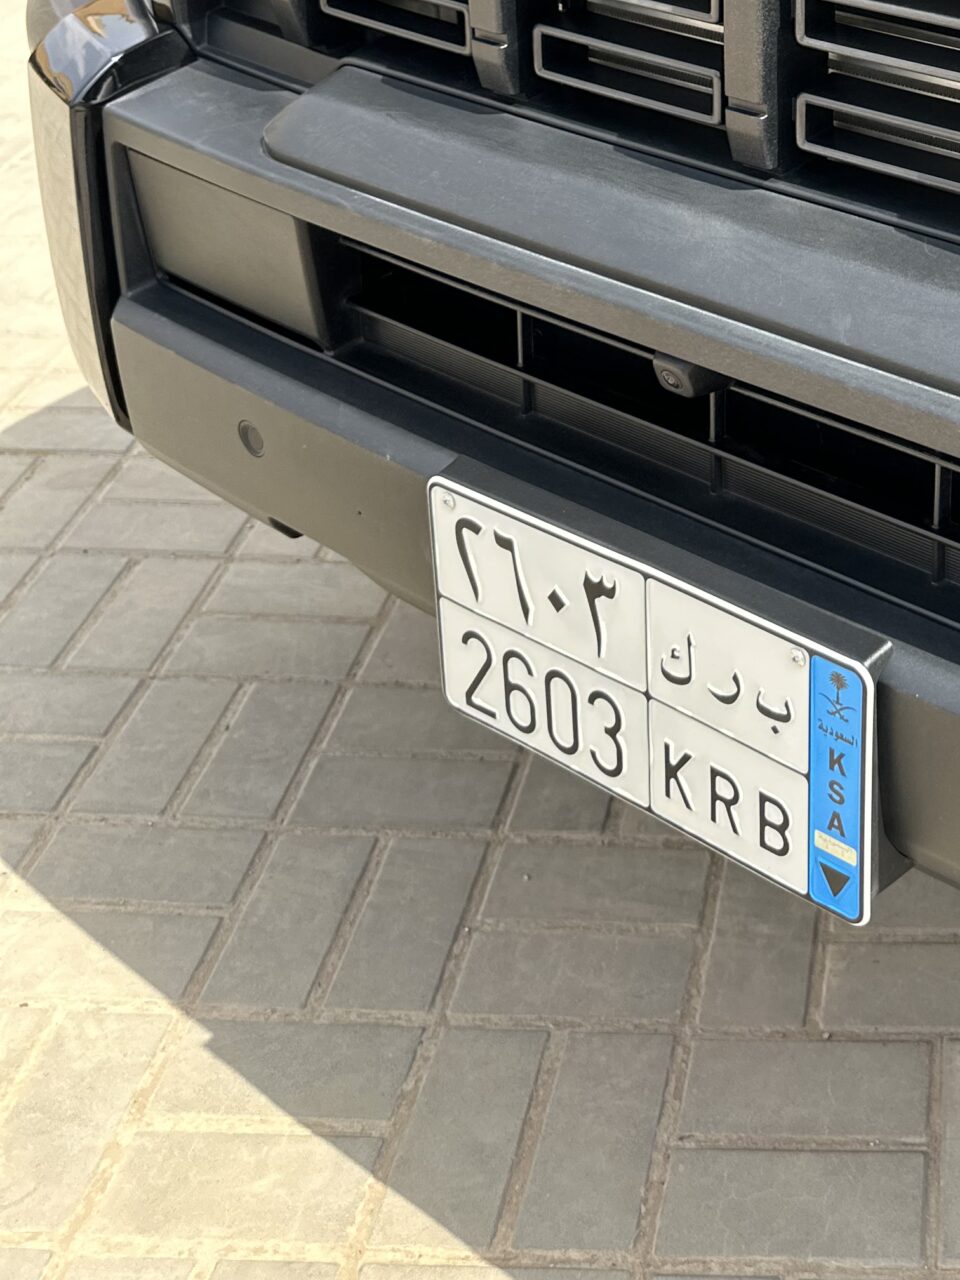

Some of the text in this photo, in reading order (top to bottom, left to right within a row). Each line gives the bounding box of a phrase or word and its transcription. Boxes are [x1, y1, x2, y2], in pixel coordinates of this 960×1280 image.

[455, 517, 617, 658] ٢٦٠٣
[462, 631, 623, 777] 2603
[664, 739, 790, 857] KRB
[827, 746, 847, 838] KSA
